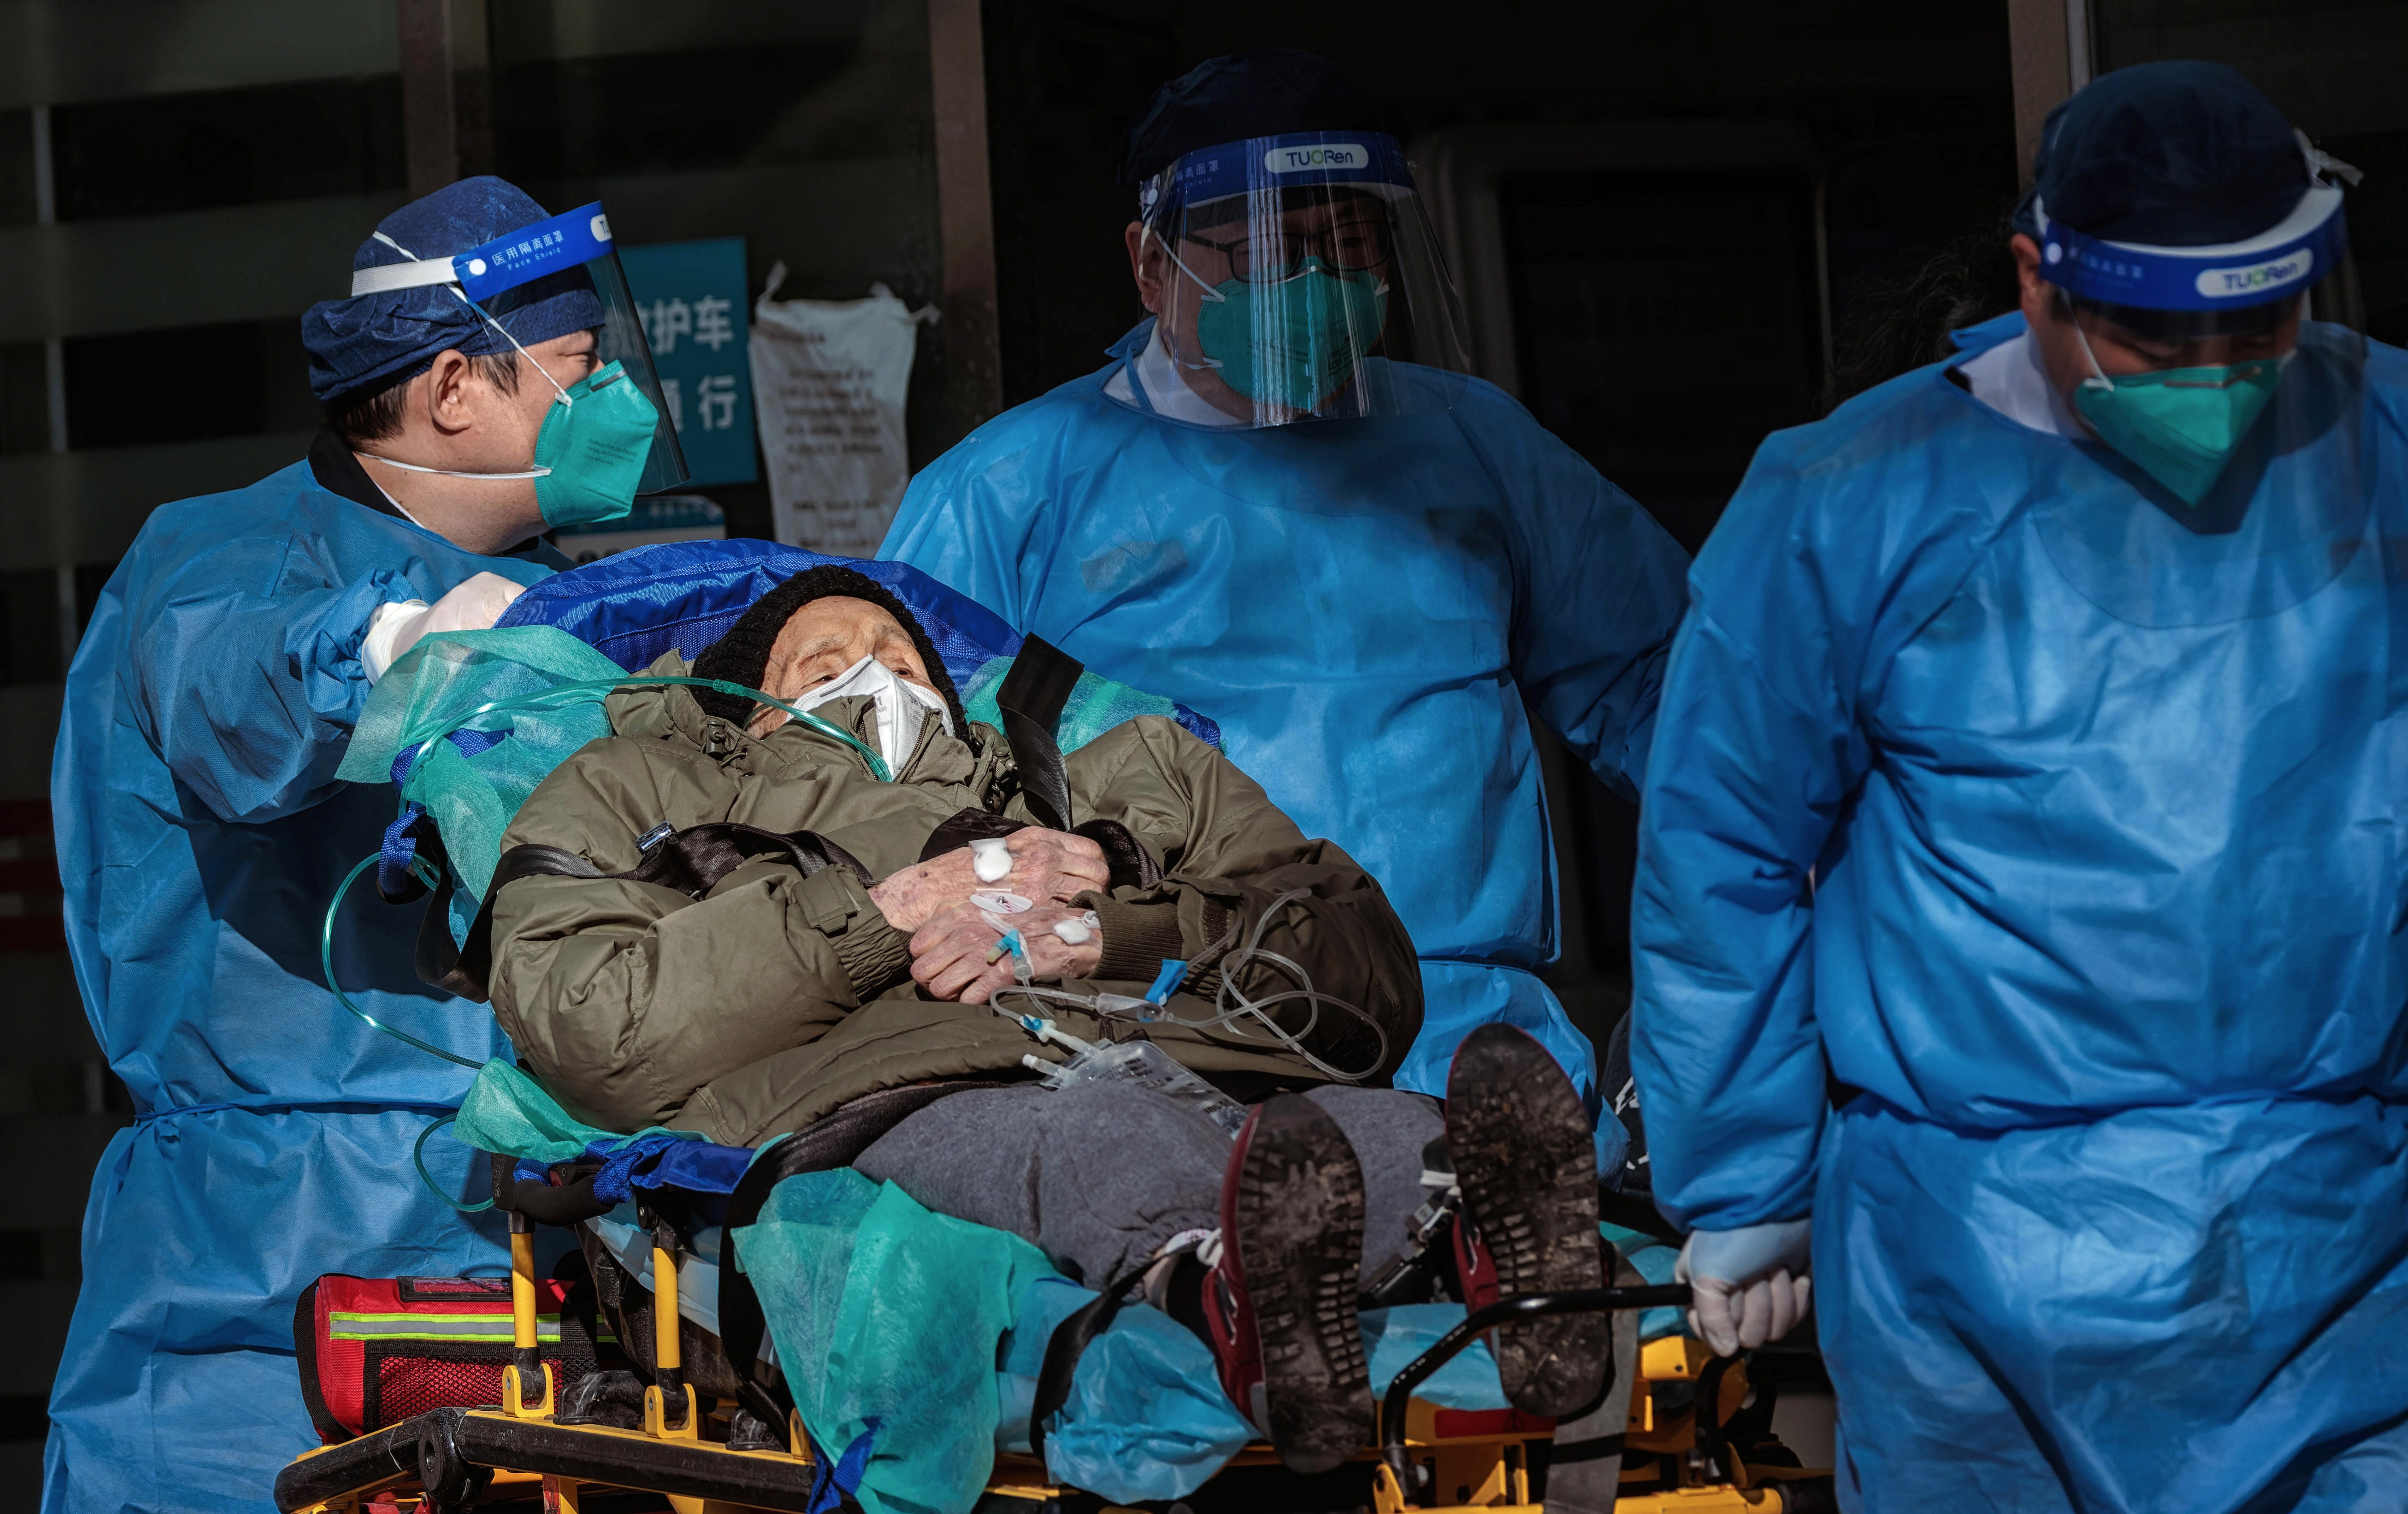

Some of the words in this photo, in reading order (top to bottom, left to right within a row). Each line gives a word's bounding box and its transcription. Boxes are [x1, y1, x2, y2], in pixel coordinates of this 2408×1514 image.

[1286, 149, 1353, 166] TUORen
[491, 230, 564, 267] 医用隔离面罩
[508, 257, 531, 271] Face
[534, 246, 562, 261] Shield
[2224, 262, 2298, 290] TUORen
